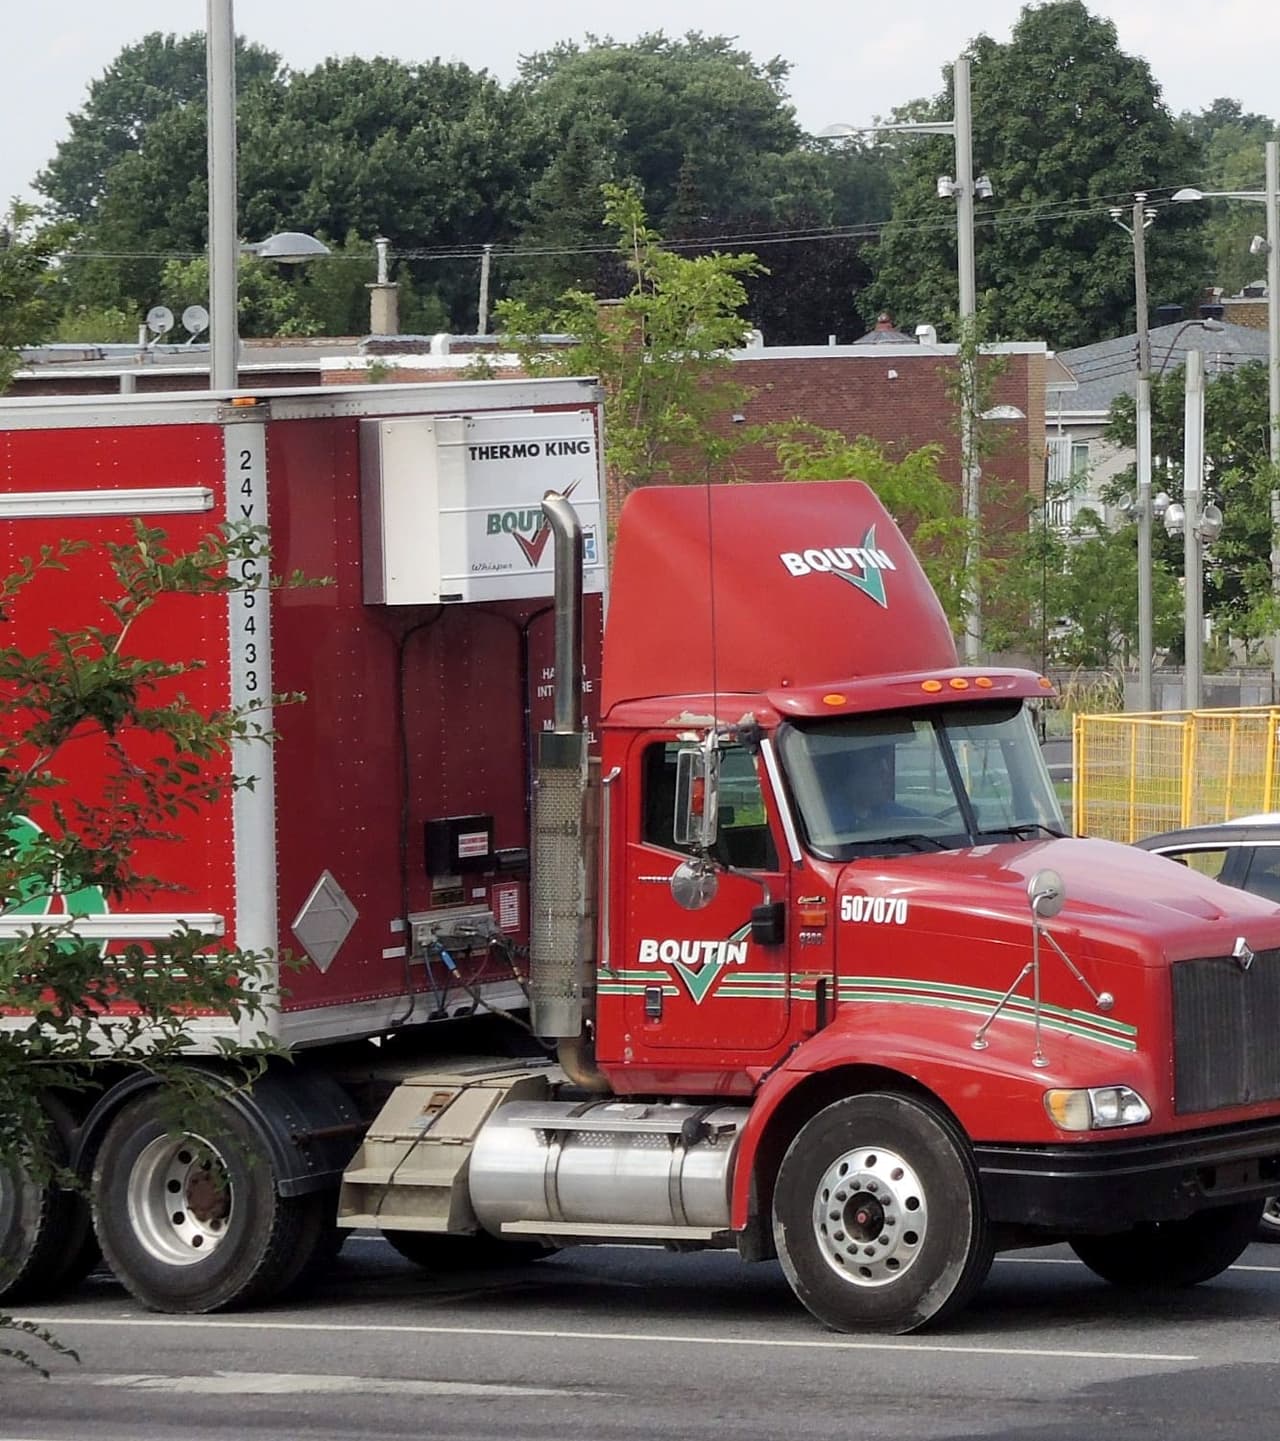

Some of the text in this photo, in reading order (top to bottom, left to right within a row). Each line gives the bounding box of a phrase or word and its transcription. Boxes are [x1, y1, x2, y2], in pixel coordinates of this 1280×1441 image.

[469, 441, 590, 460] THERMO KING
[486, 509, 546, 535] BOUT
[780, 547, 896, 576] BOUTIN
[841, 896, 907, 924] 507070
[639, 939, 748, 964] BOUTIN
